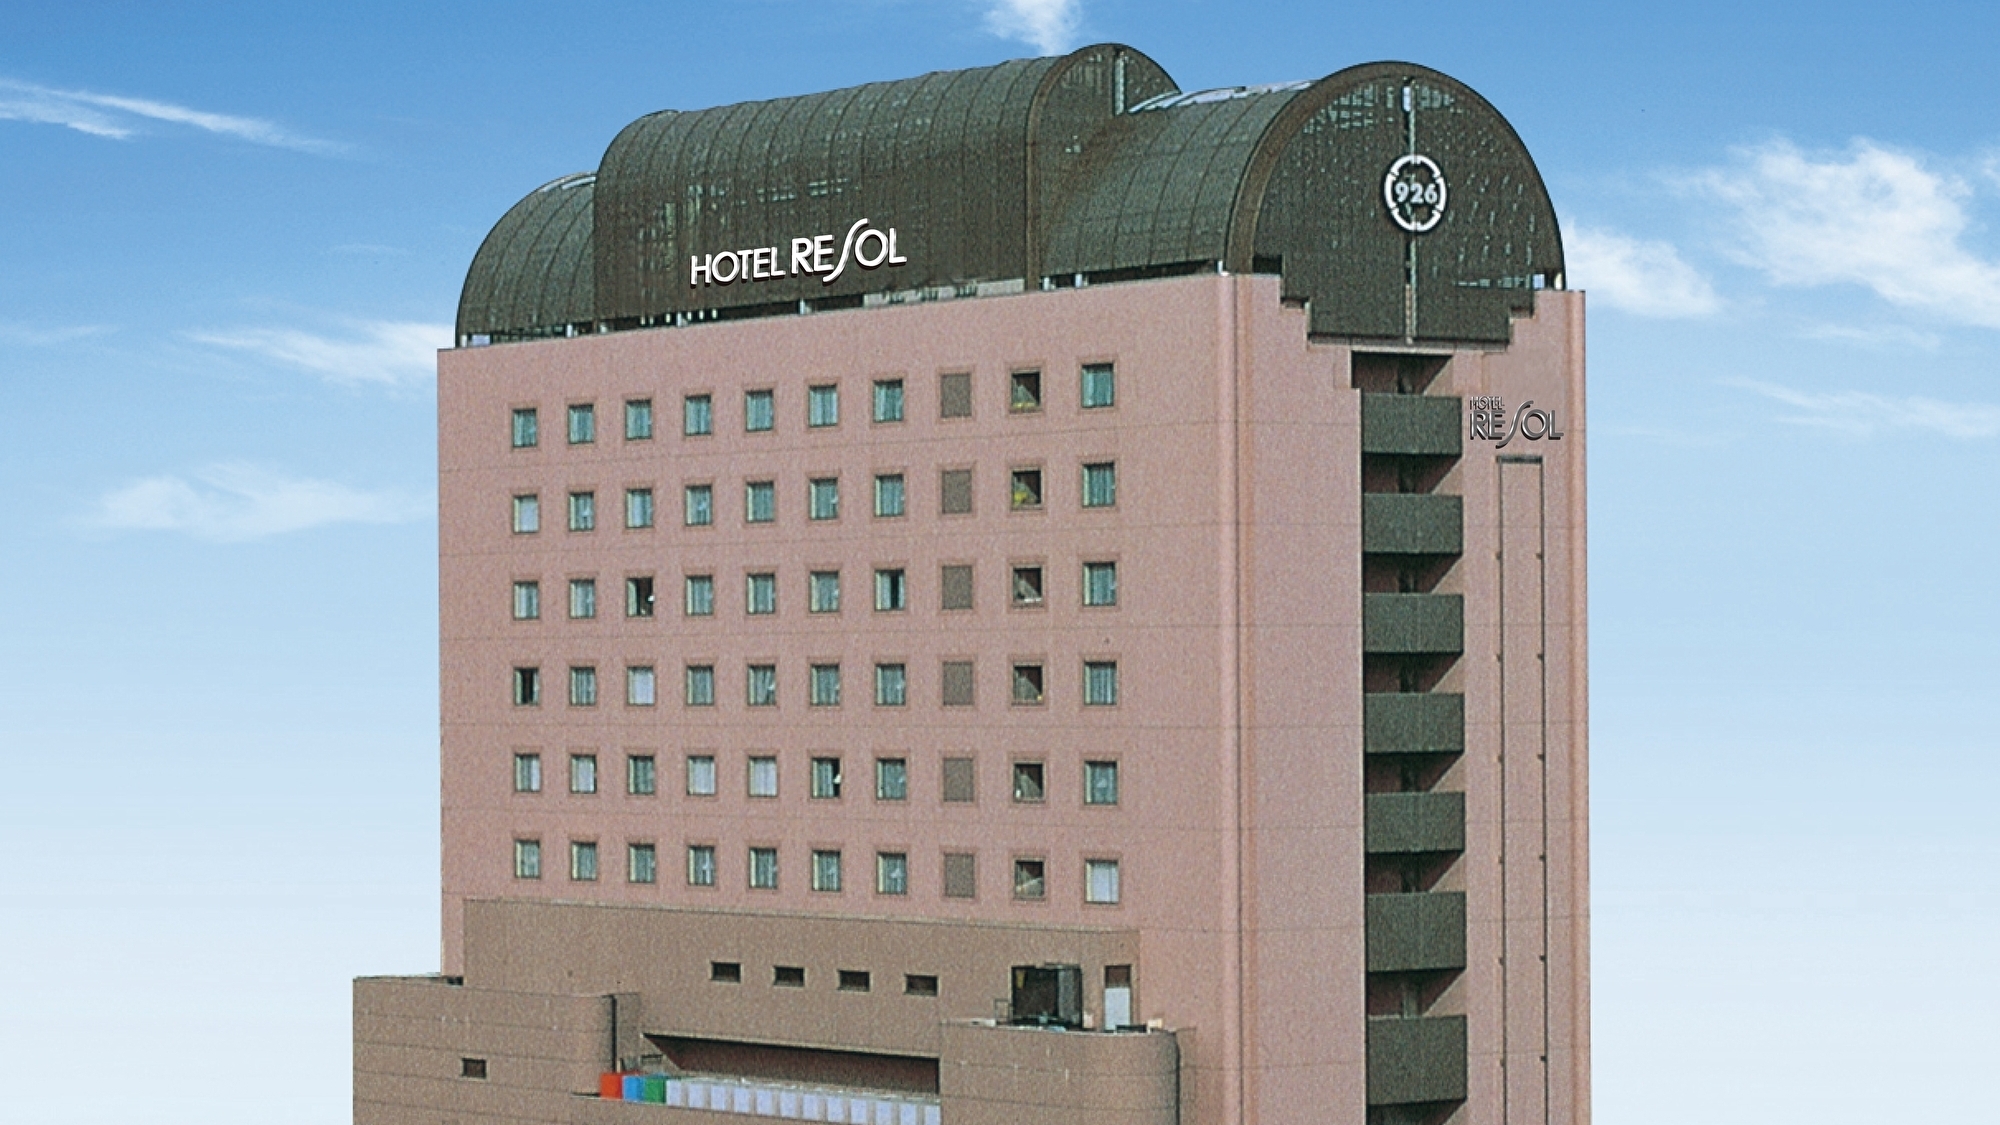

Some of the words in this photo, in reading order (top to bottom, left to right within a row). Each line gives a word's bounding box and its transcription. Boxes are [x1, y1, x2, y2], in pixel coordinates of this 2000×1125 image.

[1395, 181, 1438, 204] 926
[690, 246, 786, 286] HOTEL
[791, 217, 908, 284] RESOL
[1469, 396, 1505, 410] HOTEL
[1469, 400, 1565, 449] RESOL
